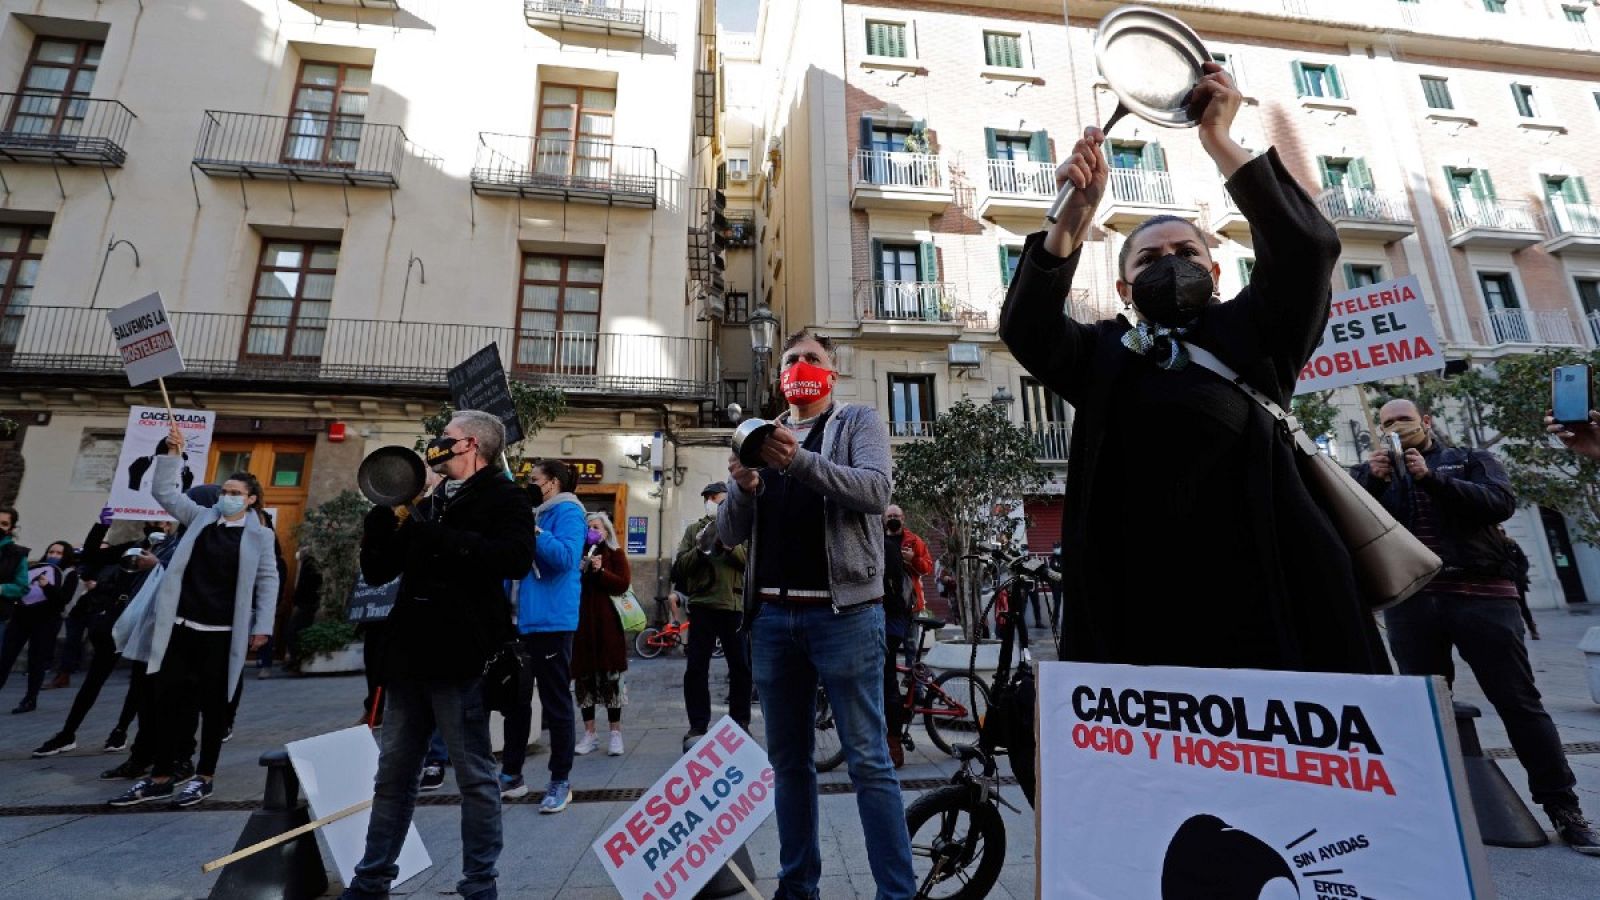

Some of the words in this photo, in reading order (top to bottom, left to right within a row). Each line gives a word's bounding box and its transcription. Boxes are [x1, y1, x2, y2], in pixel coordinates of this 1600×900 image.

[1329, 285, 1416, 318] TELERÍA
[114, 313, 153, 340] SALVEMOS
[154, 309, 166, 325] LA
[1332, 319, 1364, 343] ES
[1372, 311, 1406, 335] EL
[1298, 336, 1434, 381] ROBLEMA
[1072, 685, 1384, 755] CACEROLADA
[1072, 723, 1133, 756] OCIO
[1143, 732, 1162, 760] Y
[1173, 736, 1397, 796] HOSTELERÍA
[603, 724, 745, 869] RESCATE
[642, 810, 704, 872] PARA
[700, 765, 744, 812] LOS
[1293, 851, 1317, 868] SIN
[1319, 834, 1370, 861] AYUDAS
[1313, 880, 1358, 898] ERTES
